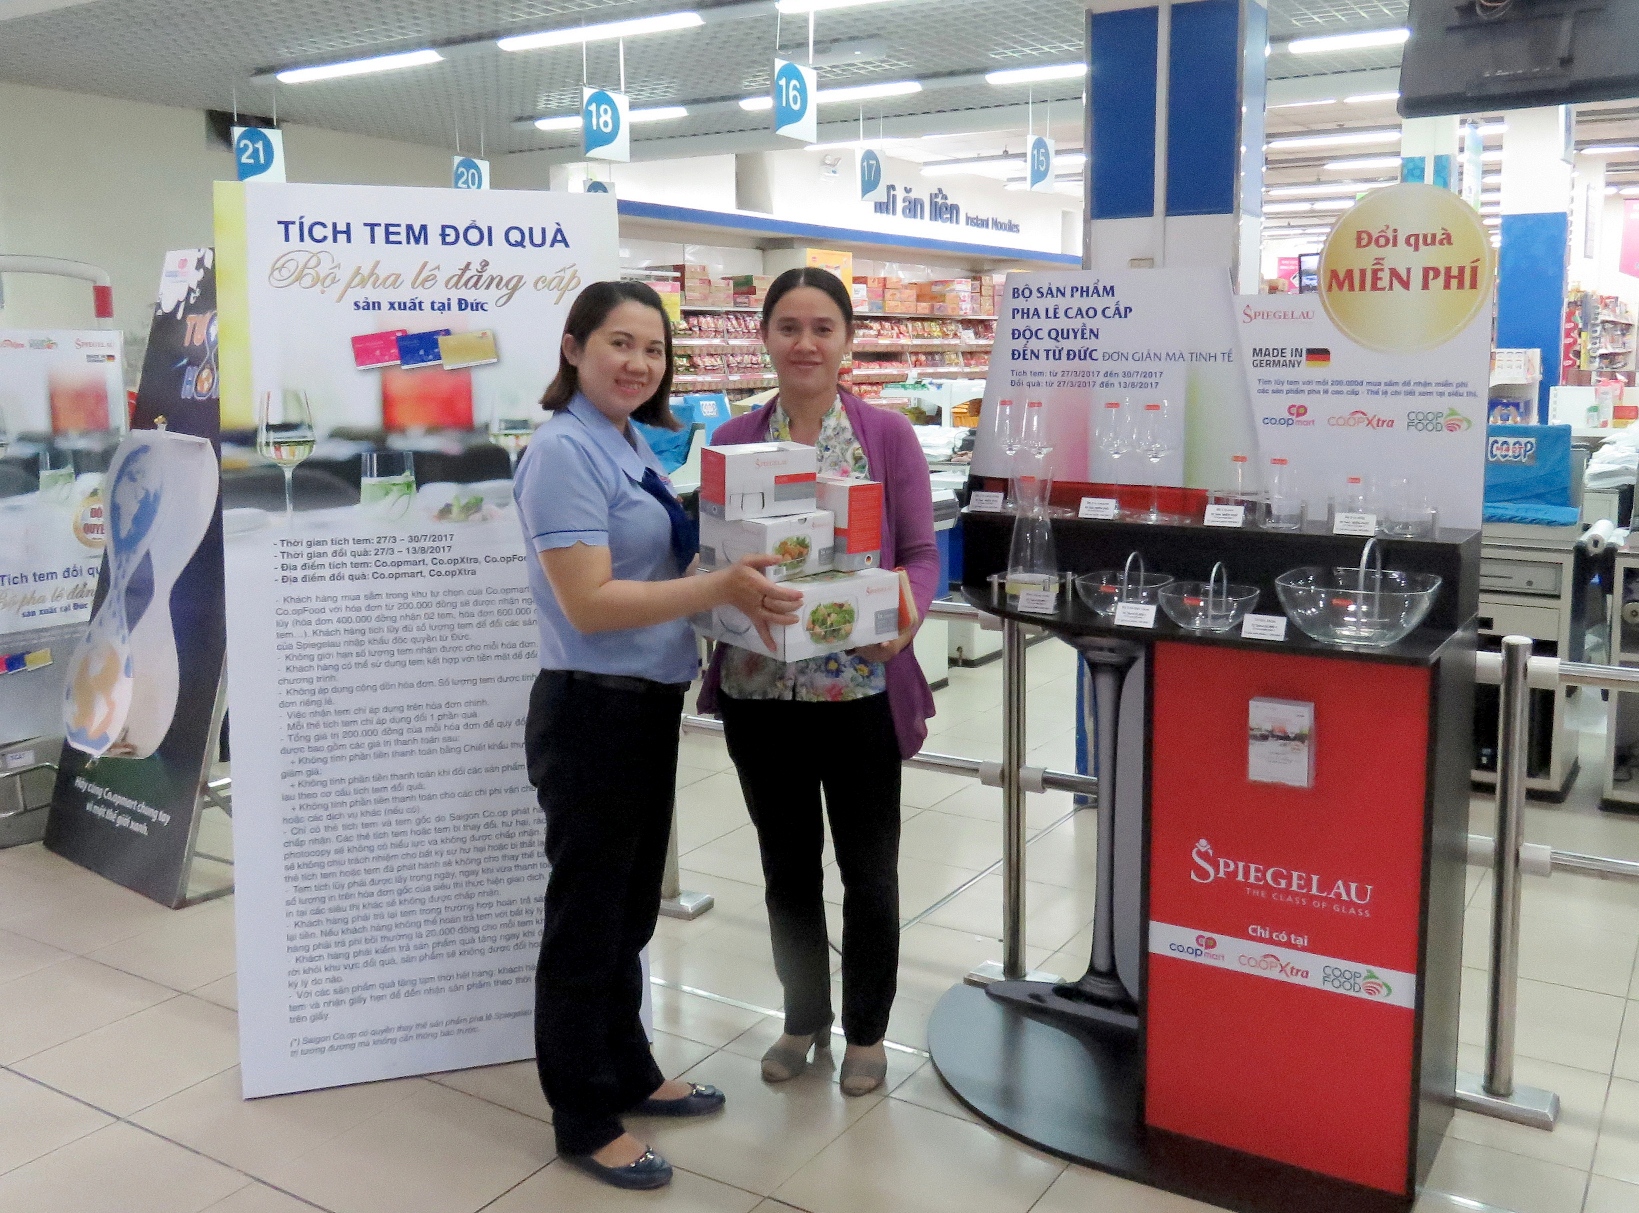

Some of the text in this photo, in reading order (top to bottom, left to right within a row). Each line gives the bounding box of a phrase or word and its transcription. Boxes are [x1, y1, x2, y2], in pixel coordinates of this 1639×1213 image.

[778, 76, 801, 110] 16
[588, 102, 613, 133] 18
[240, 139, 264, 164] 21
[1033, 149, 1046, 172] 15
[458, 167, 478, 189] 20
[862, 160, 876, 181] 17
[902, 186, 925, 220] ăn
[930, 188, 960, 225] liền
[965, 212, 989, 229] Instant
[991, 217, 1020, 233] Noodles
[277, 215, 570, 249] TÍCH TEM ĐỔI QUÀ
[1355, 225, 1453, 252] Đổi quà
[268, 250, 583, 308] Bộ pha lê đẳng cấp
[1326, 257, 1481, 292] MIỄN PHÍ
[1011, 279, 1115, 301] BỘ SẢN PHẨM
[353, 297, 489, 315] sản xuất tại Đức
[1011, 301, 1133, 319] PHA LÊ CAO CẤP
[1242, 305, 1315, 323] SPIEGELAU
[1011, 323, 1100, 343] ĐỘC QUYỀN
[1011, 342, 1040, 361] ĐẾN
[1043, 346, 1064, 361] TỪ
[1066, 346, 1099, 361] ĐỨC
[1102, 350, 1129, 362] ĐƠN
[1132, 349, 1162, 362] GIẢN
[1188, 350, 1217, 362] TINH
[1220, 348, 1234, 363] TẾ
[1252, 347, 1303, 358] MADE IN
[1011, 369, 1028, 378] Tích
[1030, 370, 1047, 378] tem:
[1061, 370, 1101, 378] 27/3/2017
[1103, 369, 1119, 378] đến
[1122, 370, 1164, 379] 30/7/2017
[1252, 359, 1302, 368] GERMANY
[1010, 379, 1024, 387] Đổi
[1026, 380, 1044, 389] quà:
[1057, 380, 1096, 388] 27/3/2017
[1099, 379, 1115, 389] đến
[1118, 381, 1159, 389] 13/8/2017
[1407, 421, 1443, 432] FOOD
[280, 533, 454, 548] Thời gian tích tem: 27/3 30/7/2017
[280, 545, 452, 560] Thời gian đổi quà: 27/3 13/8/2017
[0, 572, 28, 587] Tích
[32, 570, 58, 583] tem
[62, 563, 83, 579] đổi
[281, 563, 298, 573] Địa
[301, 561, 326, 571] điểm
[328, 560, 347, 570] tích
[350, 560, 372, 569] tem:
[374, 557, 428, 569] Co.opmart,
[281, 568, 476, 585] Địa điểm đổi quà: Co.opmart, Co.opXtra
[1190, 838, 1373, 904] SPIEGELAU
[1246, 888, 1370, 917] THE CLASS OF GLASS
[1272, 930, 1288, 941] có
[1290, 933, 1308, 948] tại
[1322, 975, 1362, 993] FOOD
